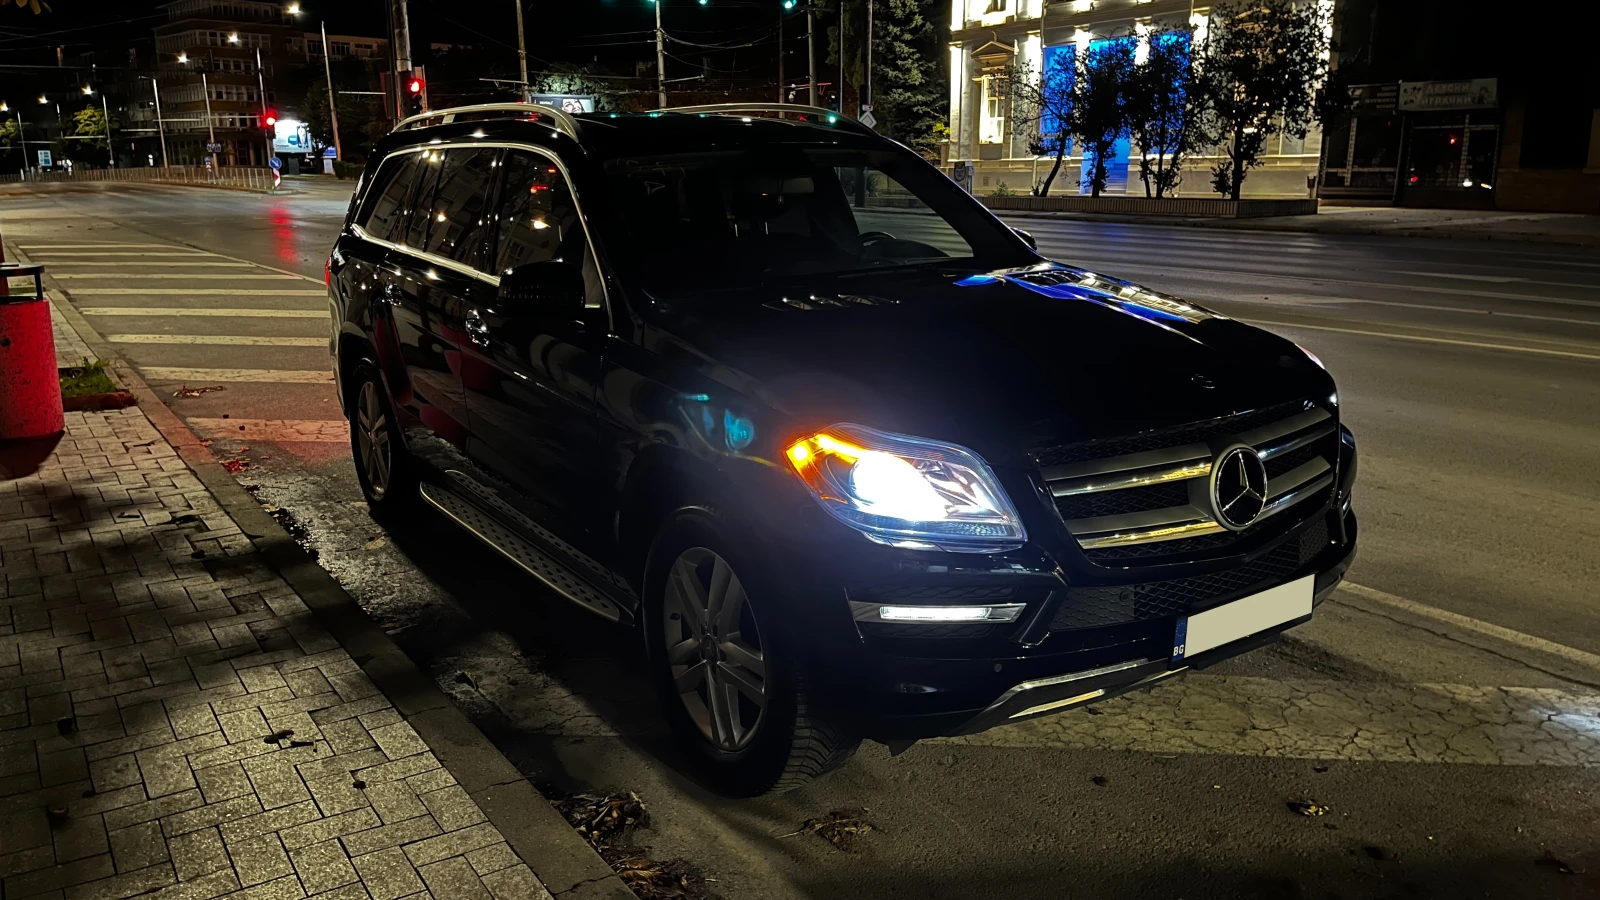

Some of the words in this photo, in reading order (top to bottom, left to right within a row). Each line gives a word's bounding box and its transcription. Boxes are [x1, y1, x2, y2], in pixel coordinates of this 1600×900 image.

[1427, 83, 1469, 94] ДЕТСКИ
[1421, 96, 1472, 106] ИГРАЧКИ
[1173, 644, 1184, 656] BG
